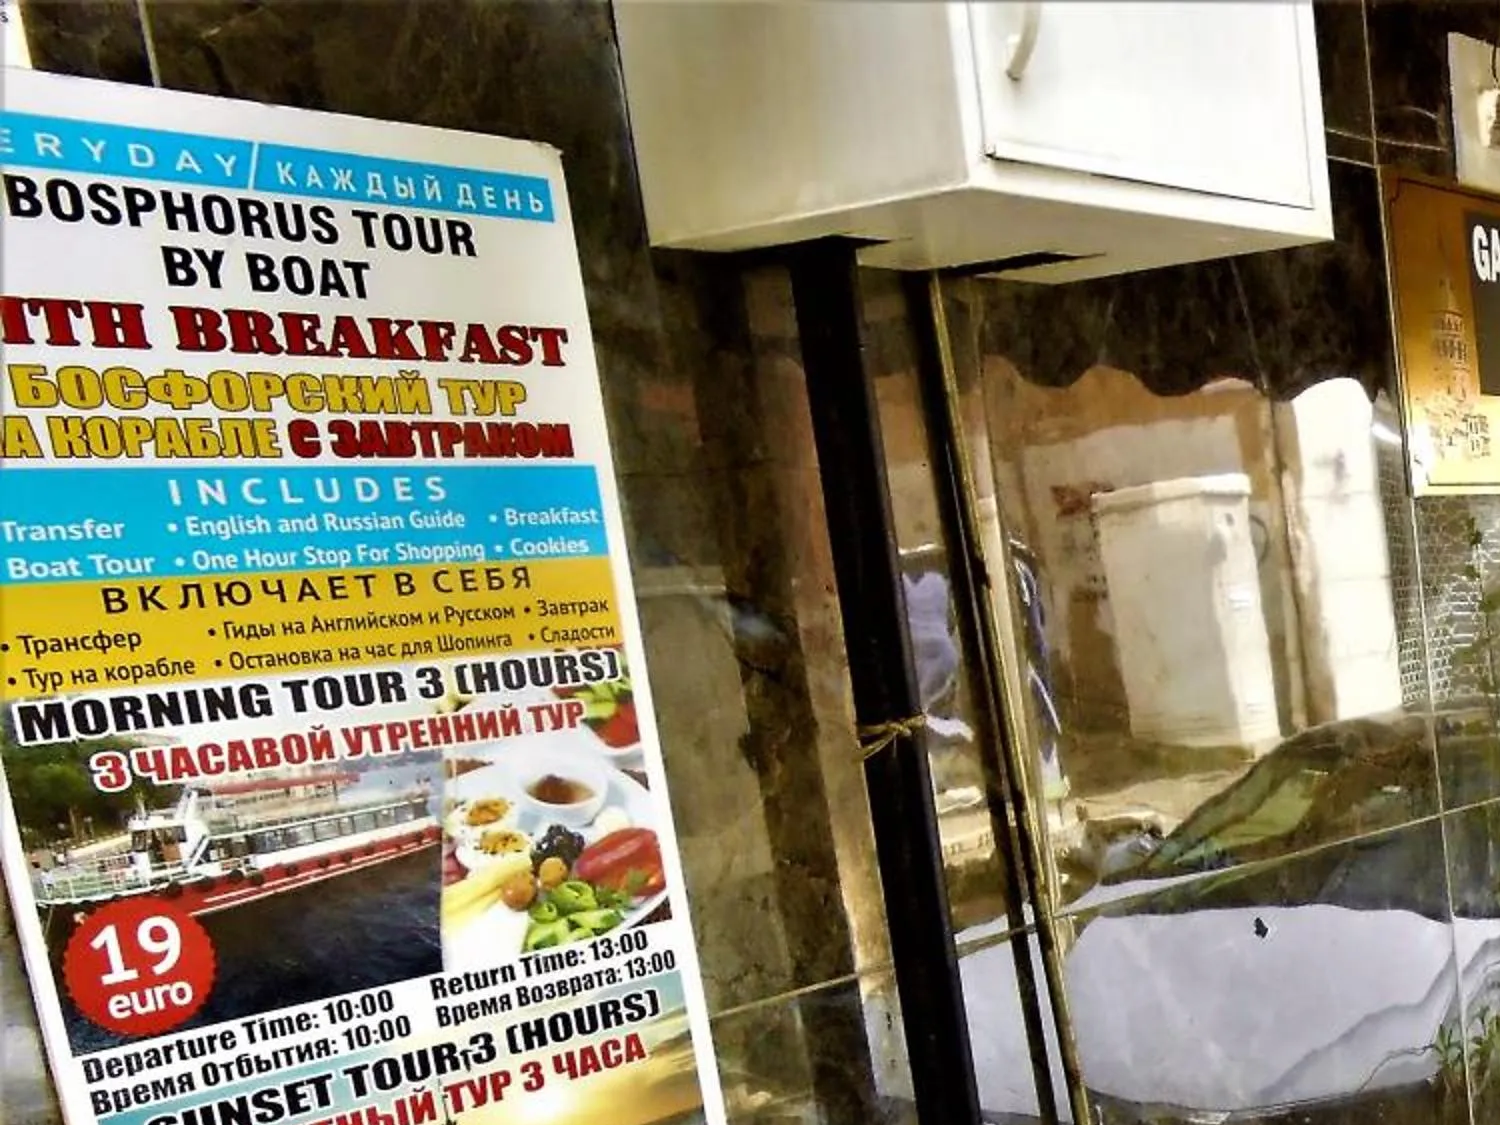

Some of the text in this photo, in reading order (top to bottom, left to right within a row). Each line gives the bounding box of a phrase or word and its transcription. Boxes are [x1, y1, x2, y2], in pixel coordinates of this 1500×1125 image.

[276, 160, 544, 214] КАЖДЫЙ ДЕНЬ
[3, 173, 478, 257] BOSPHORUS TOUR
[161, 246, 370, 299] BY BOAT
[168, 306, 568, 367] BREAKFAST
[8, 364, 527, 416] БОСФОРСКИЙ ТУР
[46, 415, 283, 459] КОРАБЛЕ
[287, 419, 320, 458] С
[327, 420, 574, 459] ЗАВТРАКОМ
[167, 476, 447, 506] INCLUDES
[2, 519, 125, 543] Transfer
[185, 508, 465, 541] English and Russian Guide
[504, 506, 601, 527] Breakfast
[7, 554, 155, 579] Boat Tour
[193, 540, 485, 570] One Hour Stop For Shopping
[510, 536, 590, 556] Cookies
[101, 566, 531, 614] ВКЛЮЧАЕТ В СЕБЯ
[537, 599, 609, 618] Завтрак
[16, 630, 142, 660] Трансфер
[223, 605, 515, 641] Гиды на Английском и Русском
[540, 622, 615, 645] Сладости
[23, 657, 195, 692] Тур на корабле
[229, 633, 512, 671] Остановка на час для Шопинга
[17, 683, 273, 743] MORNING
[281, 671, 406, 713] TOUR
[415, 666, 445, 699] 3
[135, 723, 335, 782] ЧАСАВОЙ
[340, 704, 522, 757] УТРЕННИЙ
[528, 701, 584, 734] ТУР
[90, 915, 182, 986] 19
[430, 929, 648, 1001] Return Time: 13:00
[107, 980, 193, 1020] euro
[435, 949, 676, 1029] Время Возврата: 13:00
[82, 989, 395, 1085] Departure Time: 10:00
[89, 1014, 412, 1117] Время Отбытия: 10:00
[343, 1041, 461, 1098] TOUR
[469, 1032, 497, 1065] 3
[444, 1070, 511, 1115] ТУР
[520, 1061, 545, 1093] 3
[552, 1032, 647, 1080] ЧАСА
